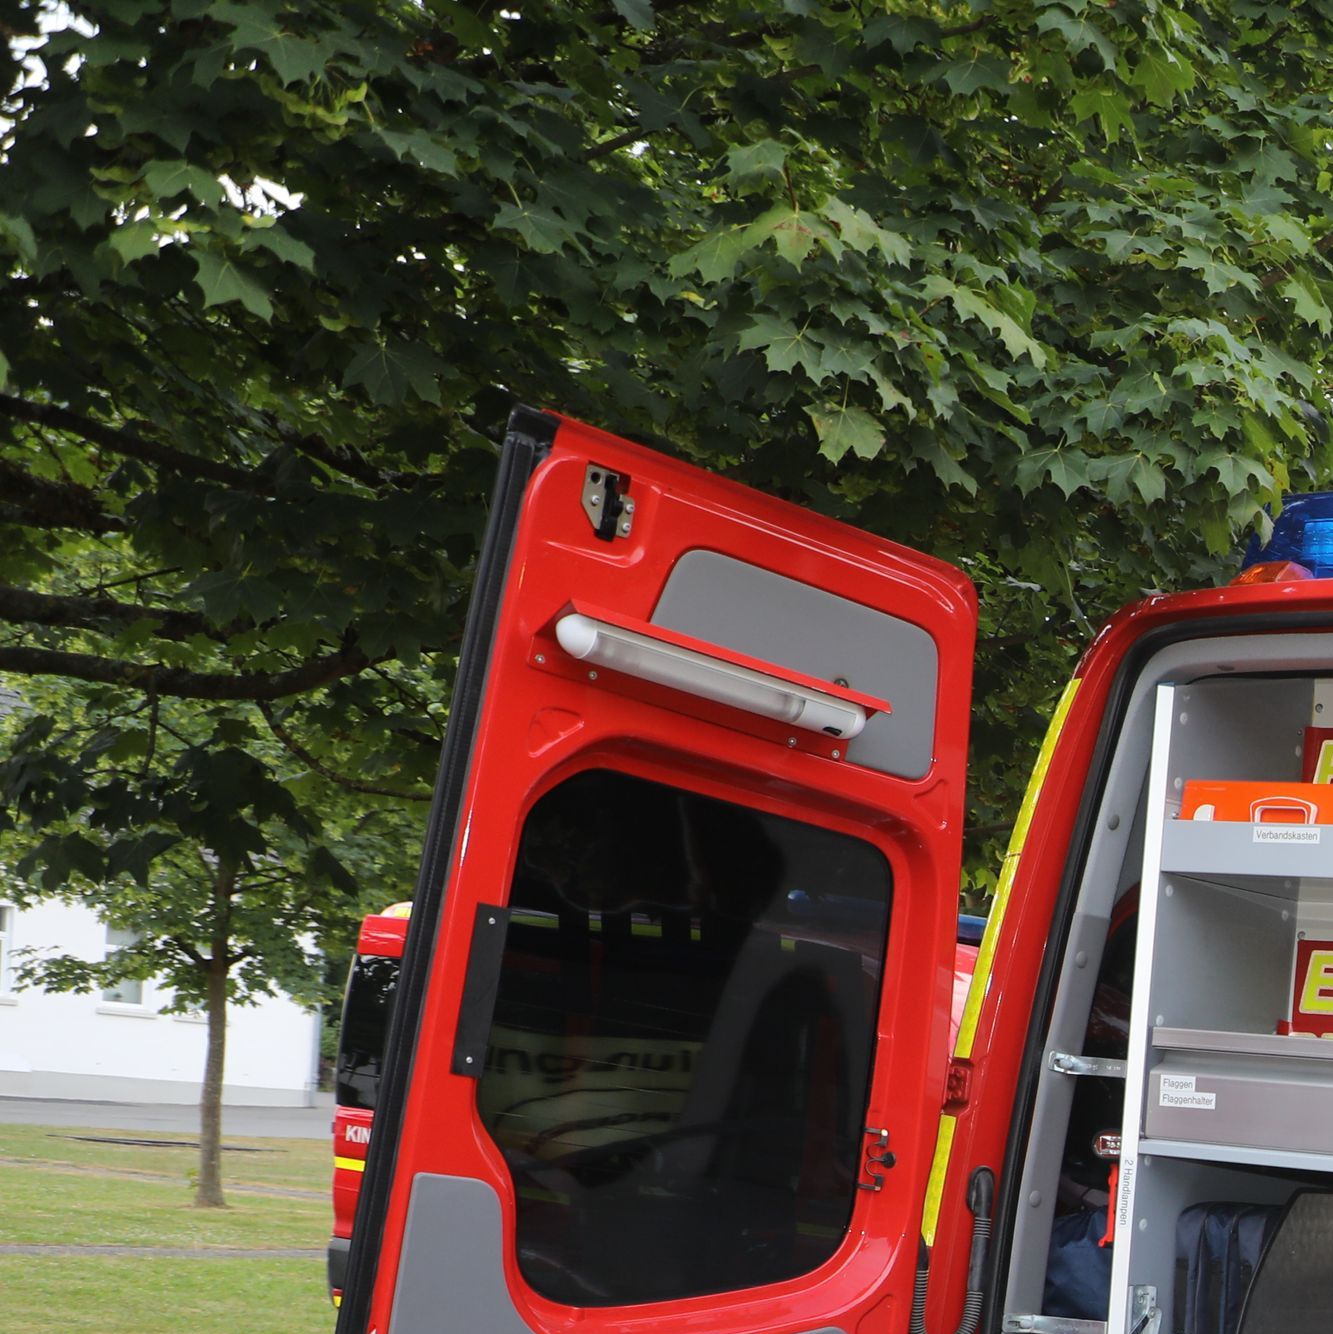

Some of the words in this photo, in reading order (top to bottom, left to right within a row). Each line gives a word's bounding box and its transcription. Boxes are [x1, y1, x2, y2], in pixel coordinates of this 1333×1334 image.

[1256, 830, 1318, 841] Verbandskasten
[1163, 1078, 1193, 1090] Flaggen
[1162, 1093, 1213, 1106] Flaggenhalter
[1124, 1159, 1134, 1167] 2
[1119, 1168, 1133, 1226] Handlampen
